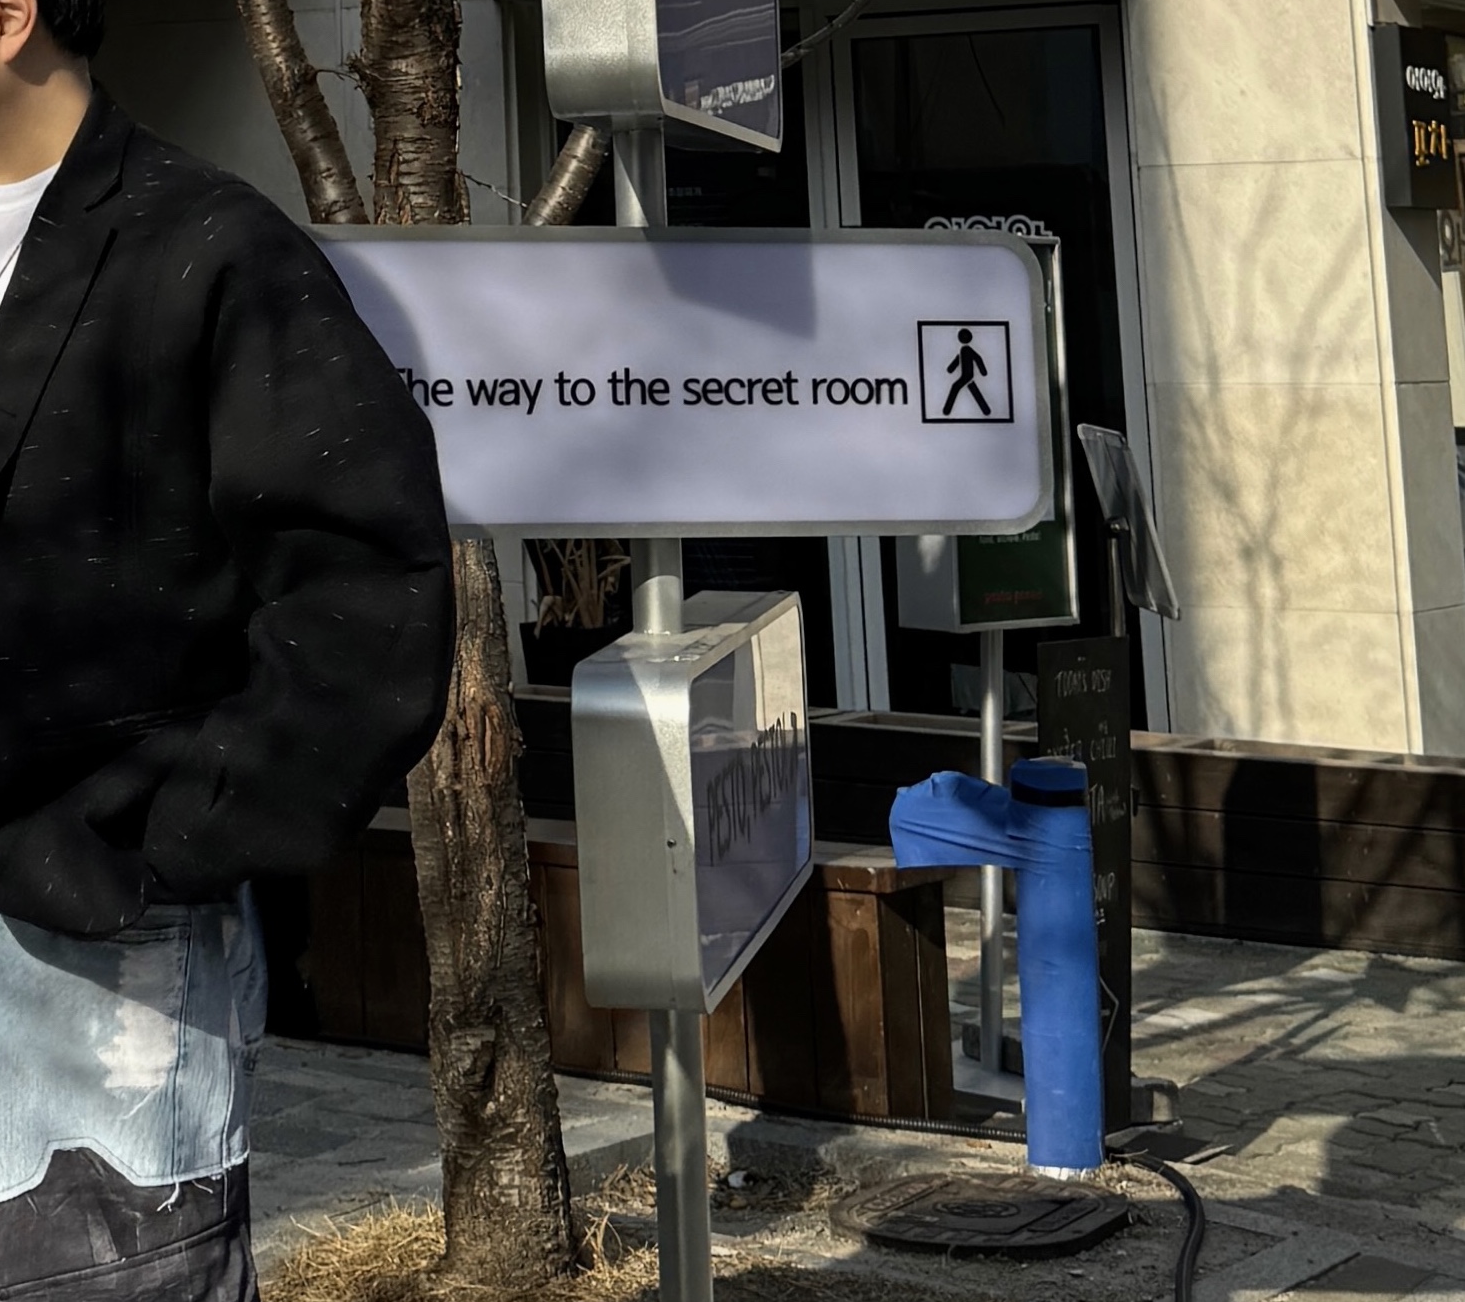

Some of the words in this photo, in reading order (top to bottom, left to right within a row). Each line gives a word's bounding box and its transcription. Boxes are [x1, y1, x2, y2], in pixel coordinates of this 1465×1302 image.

[1411, 118, 1452, 167] 포차
[395, 367, 454, 407] he
[465, 378, 544, 416] way
[553, 370, 596, 407] to
[607, 367, 671, 407] the
[682, 370, 800, 407] secret
[811, 377, 908, 406] room
